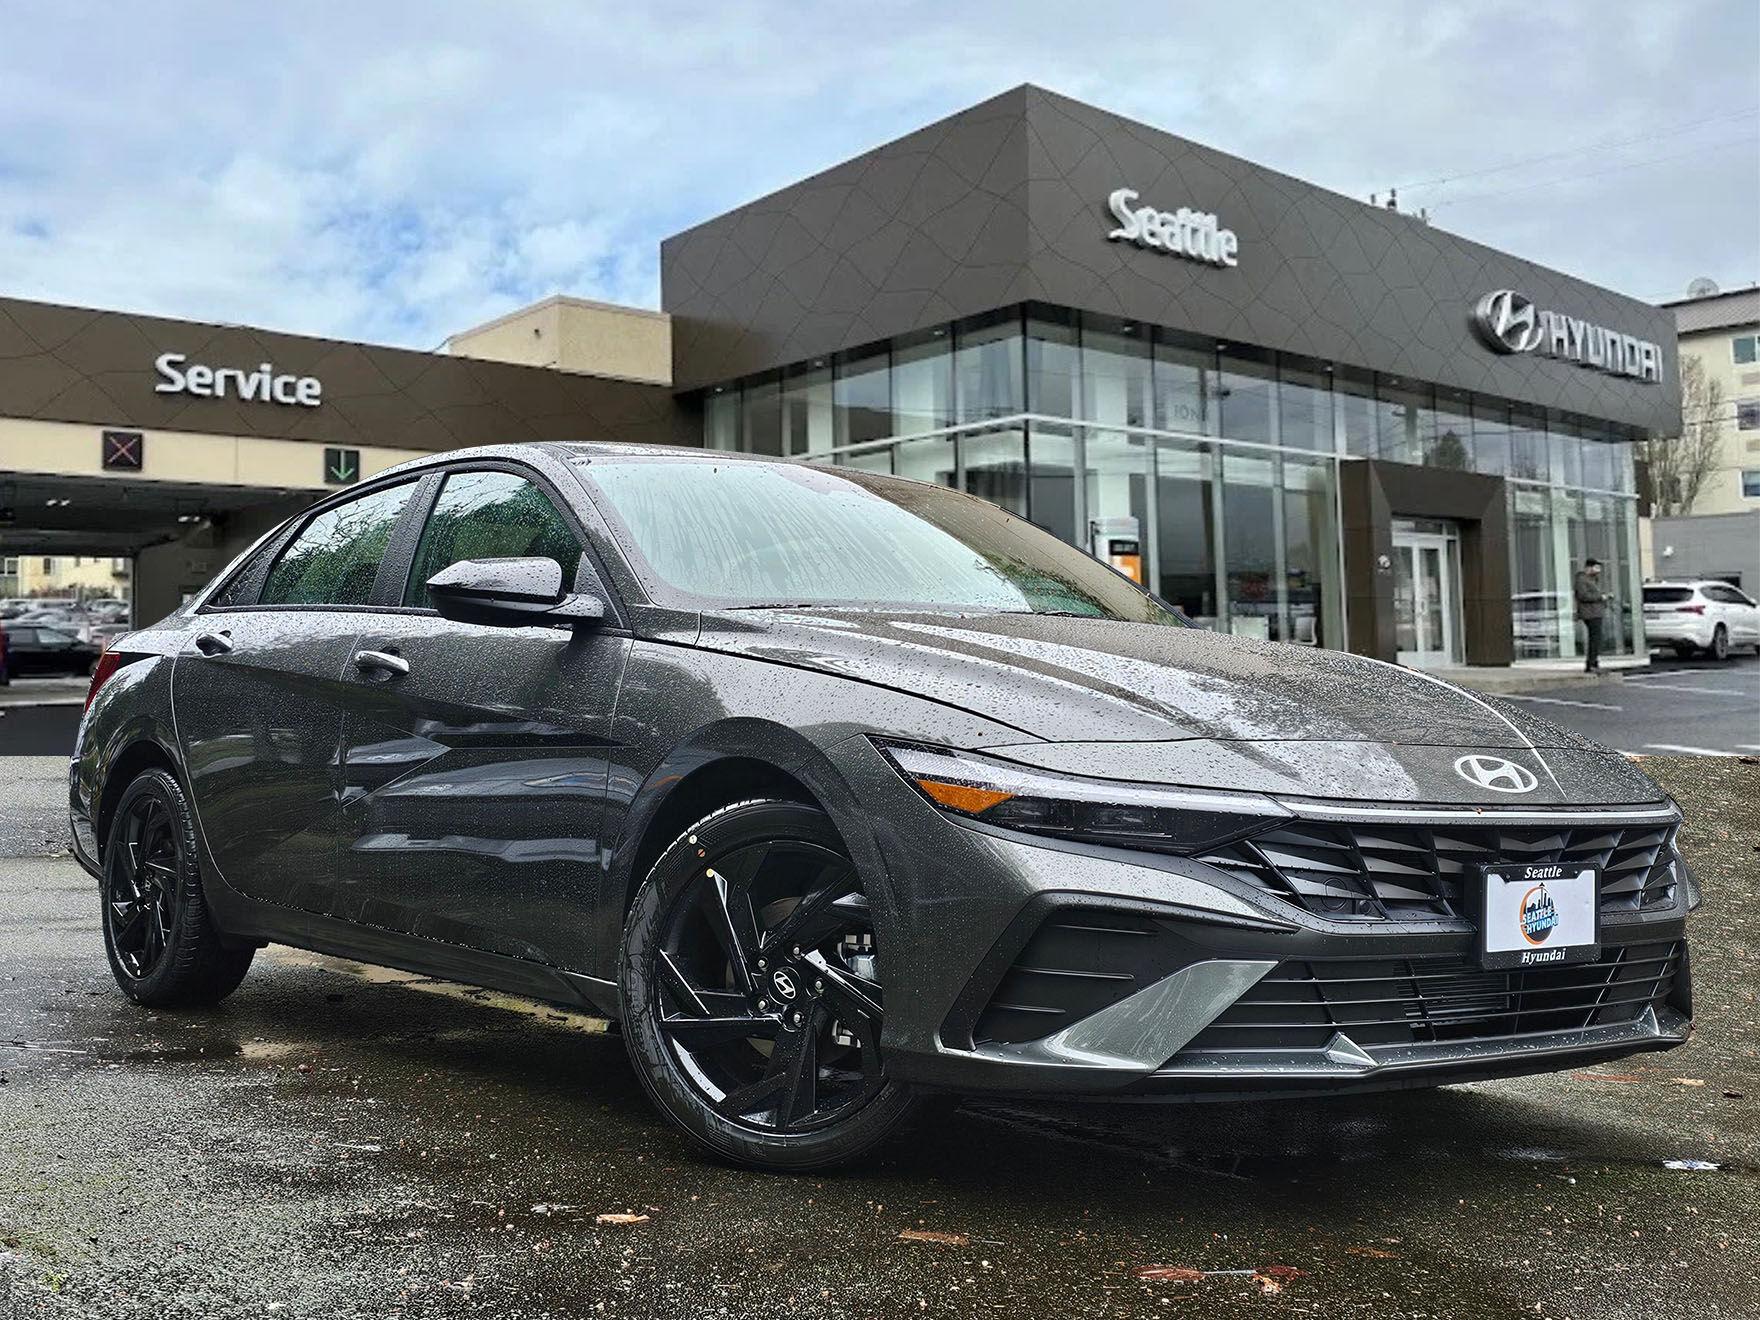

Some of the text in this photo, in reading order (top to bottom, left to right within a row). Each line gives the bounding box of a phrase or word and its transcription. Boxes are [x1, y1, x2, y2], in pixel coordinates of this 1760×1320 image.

[1109, 188, 1238, 266] Seattle
[1547, 310, 1663, 383] HYUNDAI
[154, 352, 322, 406] Service
[1524, 866, 1563, 879] Seattle
[1522, 907, 1554, 924] SEATTLE
[1526, 912, 1560, 935] HYUNDAI
[1522, 948, 1567, 966] Hyundai
